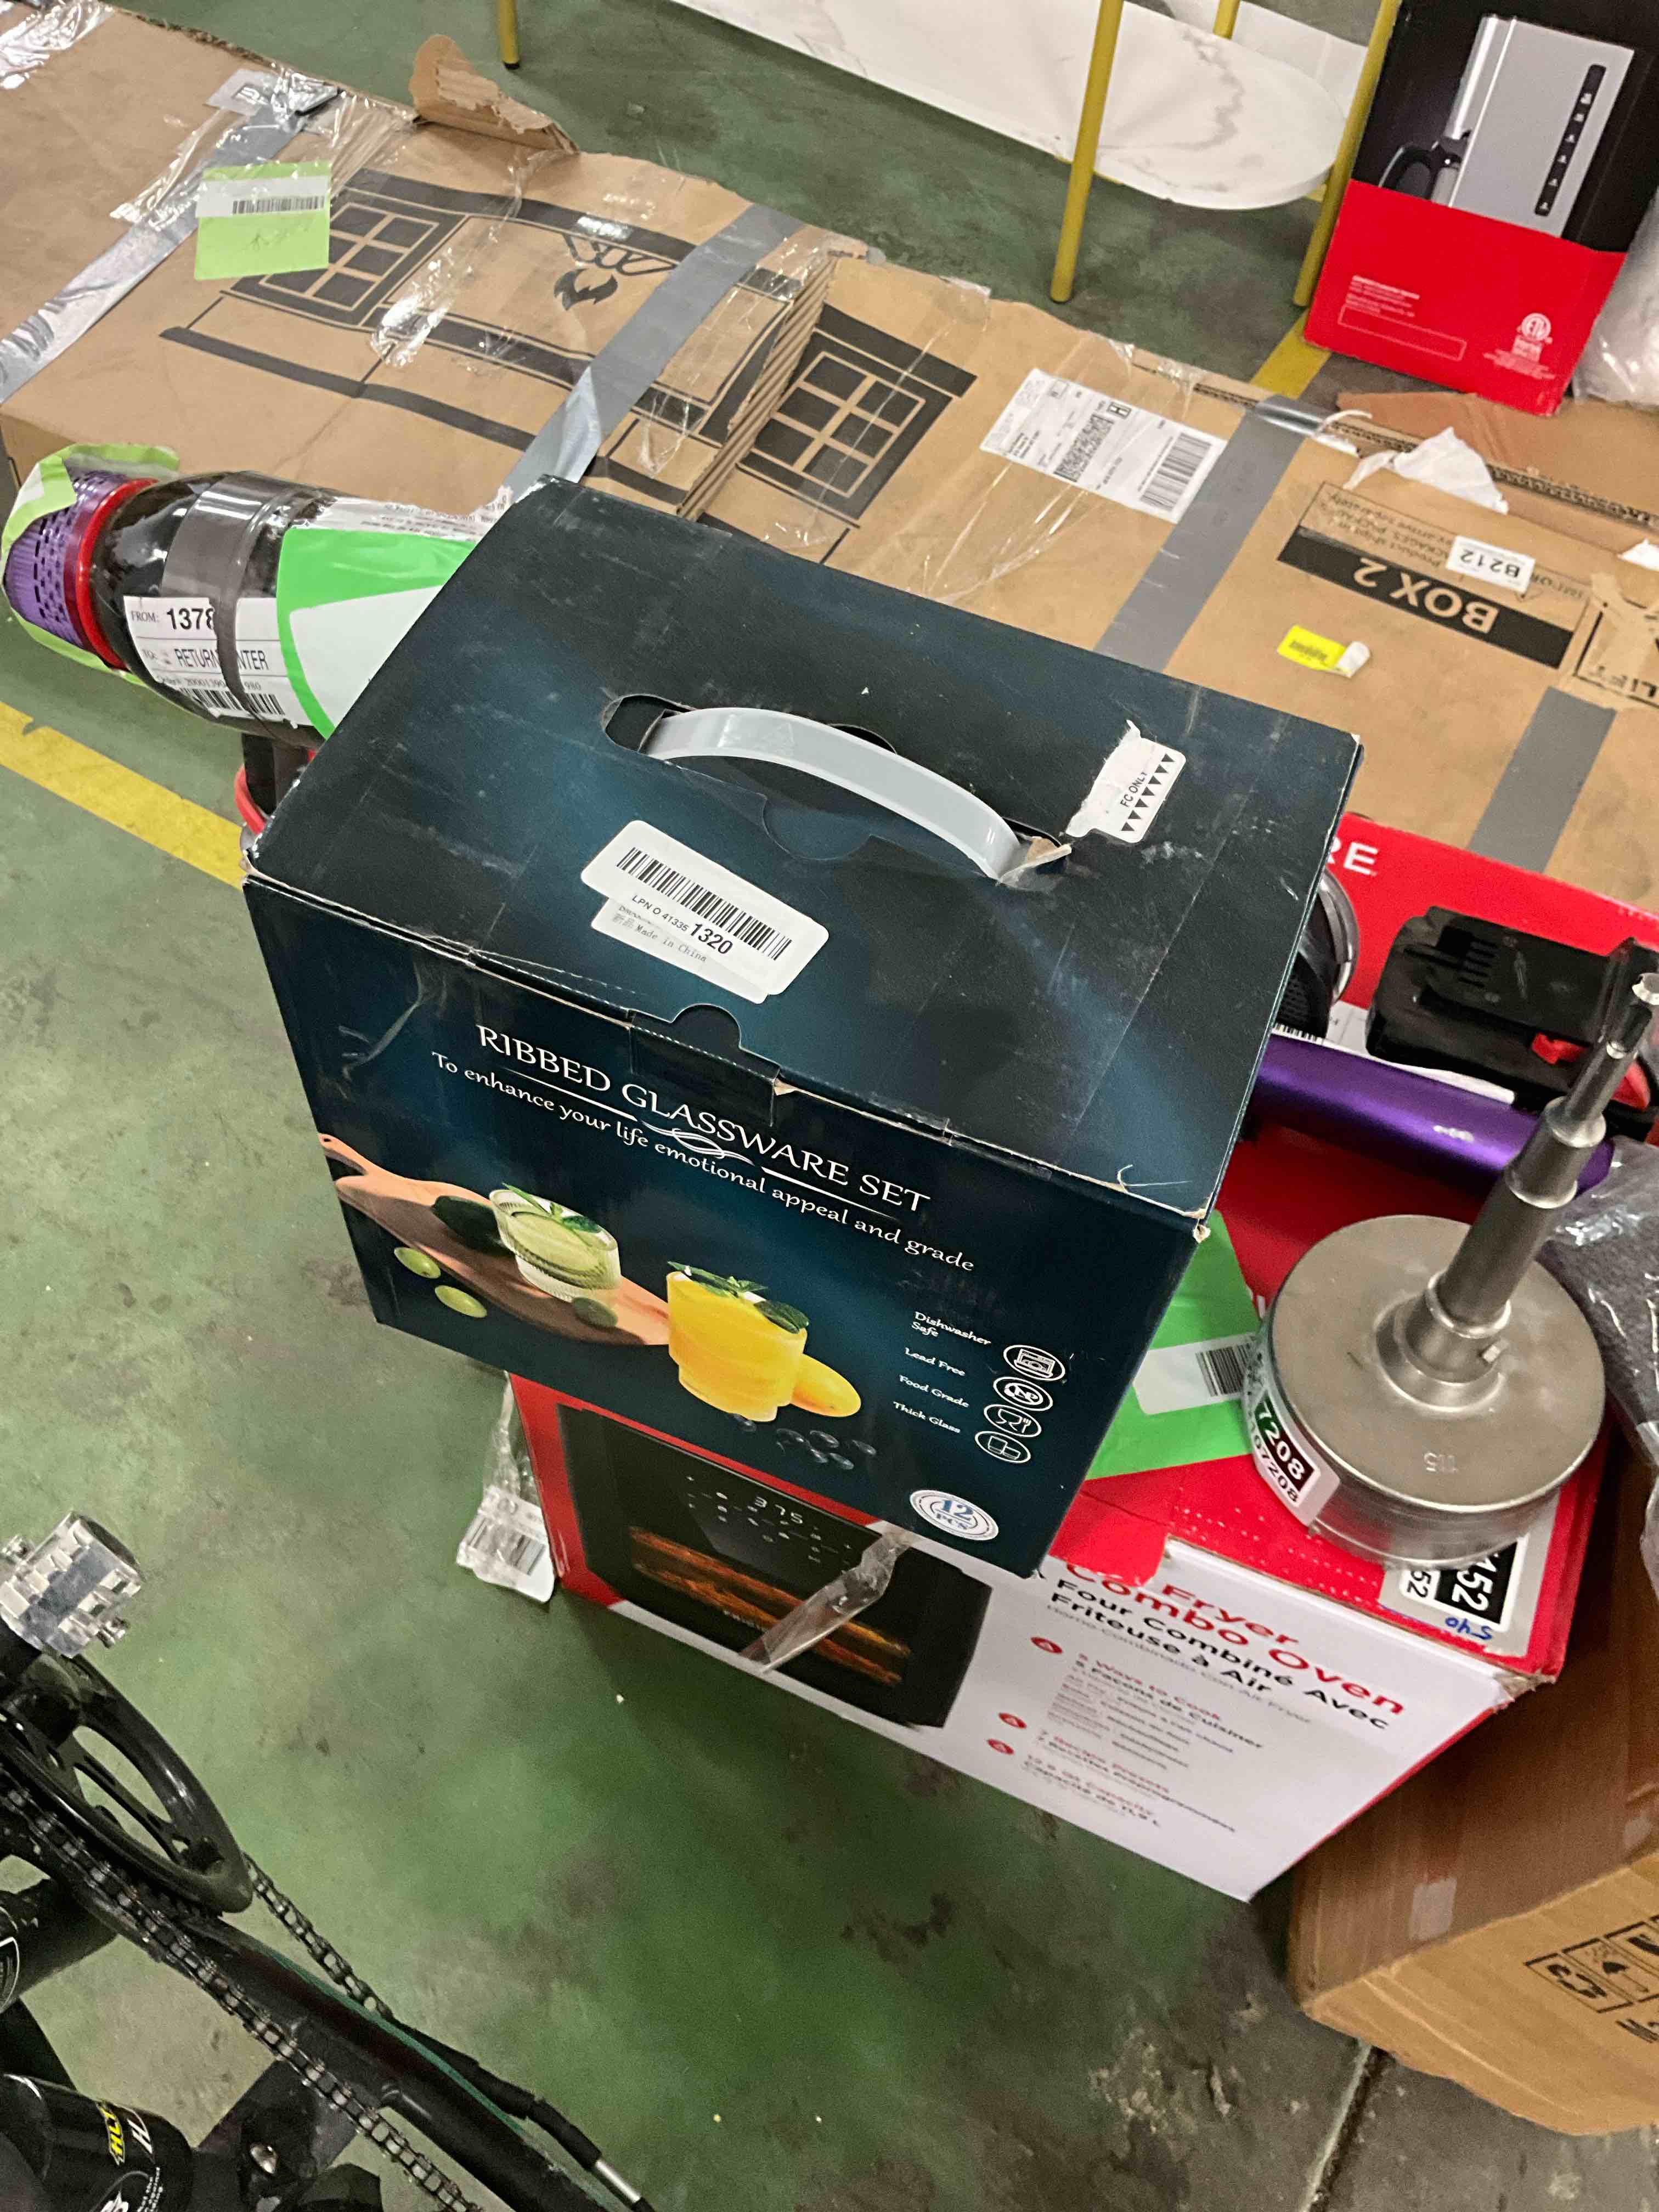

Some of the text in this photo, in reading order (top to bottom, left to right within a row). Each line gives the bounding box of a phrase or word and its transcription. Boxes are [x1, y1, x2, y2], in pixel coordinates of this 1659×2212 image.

[1353, 557, 1387, 588] 2
[1459, 549, 1521, 579] B212
[131, 610, 160, 623] FROM:
[167, 607, 215, 630] 1378
[1390, 572, 1500, 634] BOX
[174, 648, 269, 670] RETURN NTER
[1119, 793, 1135, 808] FC
[632, 895, 653, 910] LPN
[662, 913, 689, 932] 41335
[690, 923, 733, 955] 1320
[636, 924, 707, 963] Made in China
[476, 1024, 932, 1212] RIBBED GLASSWARE SET
[431, 1050, 975, 1272] To enhance your life emotional appeal and grade
[911, 1321, 939, 1338] Safe
[914, 1311, 992, 1345] Dishwasher
[905, 1346, 966, 1376] Lead Free
[898, 1374, 970, 1408] Food Grade
[892, 1401, 961, 1434] Thick Glass
[1258, 1400, 1306, 1481] 7208
[940, 1499, 974, 1522] 12
[1452, 1553, 1499, 1611] 152
[1161, 1583, 1300, 1644] Fryer
[1051, 1592, 1272, 1691] Friteuse à Air
[1057, 1579, 1133, 1615] Four
[1143, 1617, 1293, 1686] Combiné
[1303, 1689, 1389, 1730] Avec
[1066, 1564, 1249, 1646] Combo
[1268, 1648, 1404, 1715] Oven
